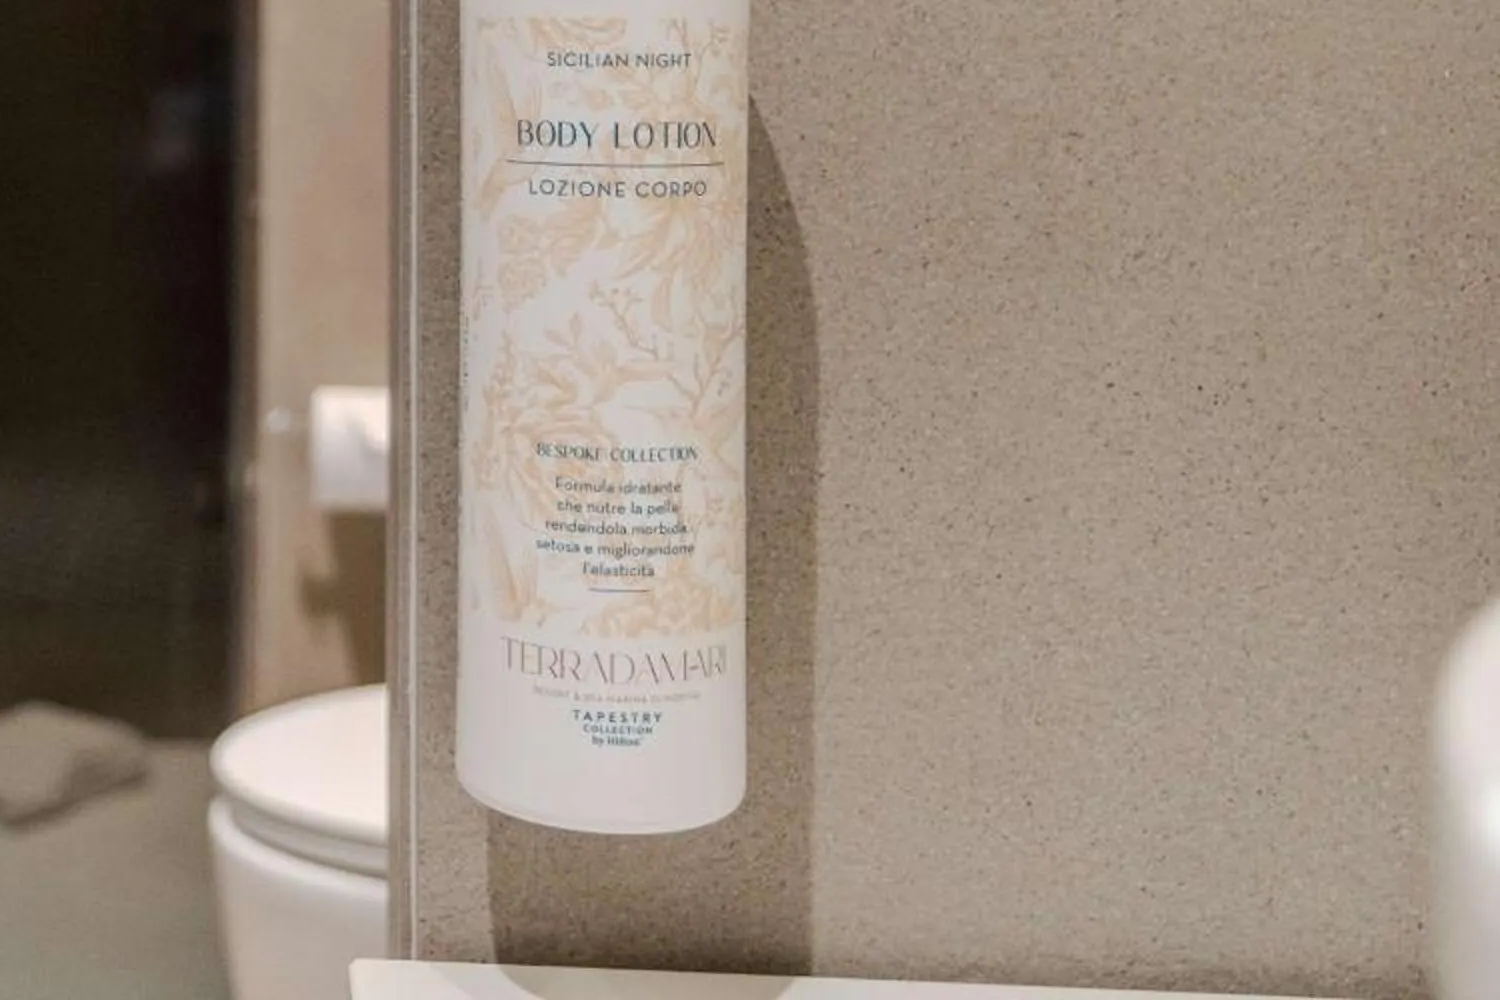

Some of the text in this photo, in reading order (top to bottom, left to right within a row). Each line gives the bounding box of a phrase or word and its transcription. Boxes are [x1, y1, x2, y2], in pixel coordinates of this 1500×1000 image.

[547, 51, 692, 68] SICILIAN NIGHT
[517, 119, 717, 149] BODY LOTION
[529, 179, 707, 199] LOZIONE CORPO
[536, 443, 699, 462] BESPOKE COLLECTION
[555, 476, 683, 494] Formula idratante
[557, 500, 679, 518] che nutre la pelle
[545, 520, 627, 535] rendendola
[584, 545, 593, 554] e
[572, 709, 663, 723] TAPESTRY
[583, 724, 654, 735] COLLECTION
